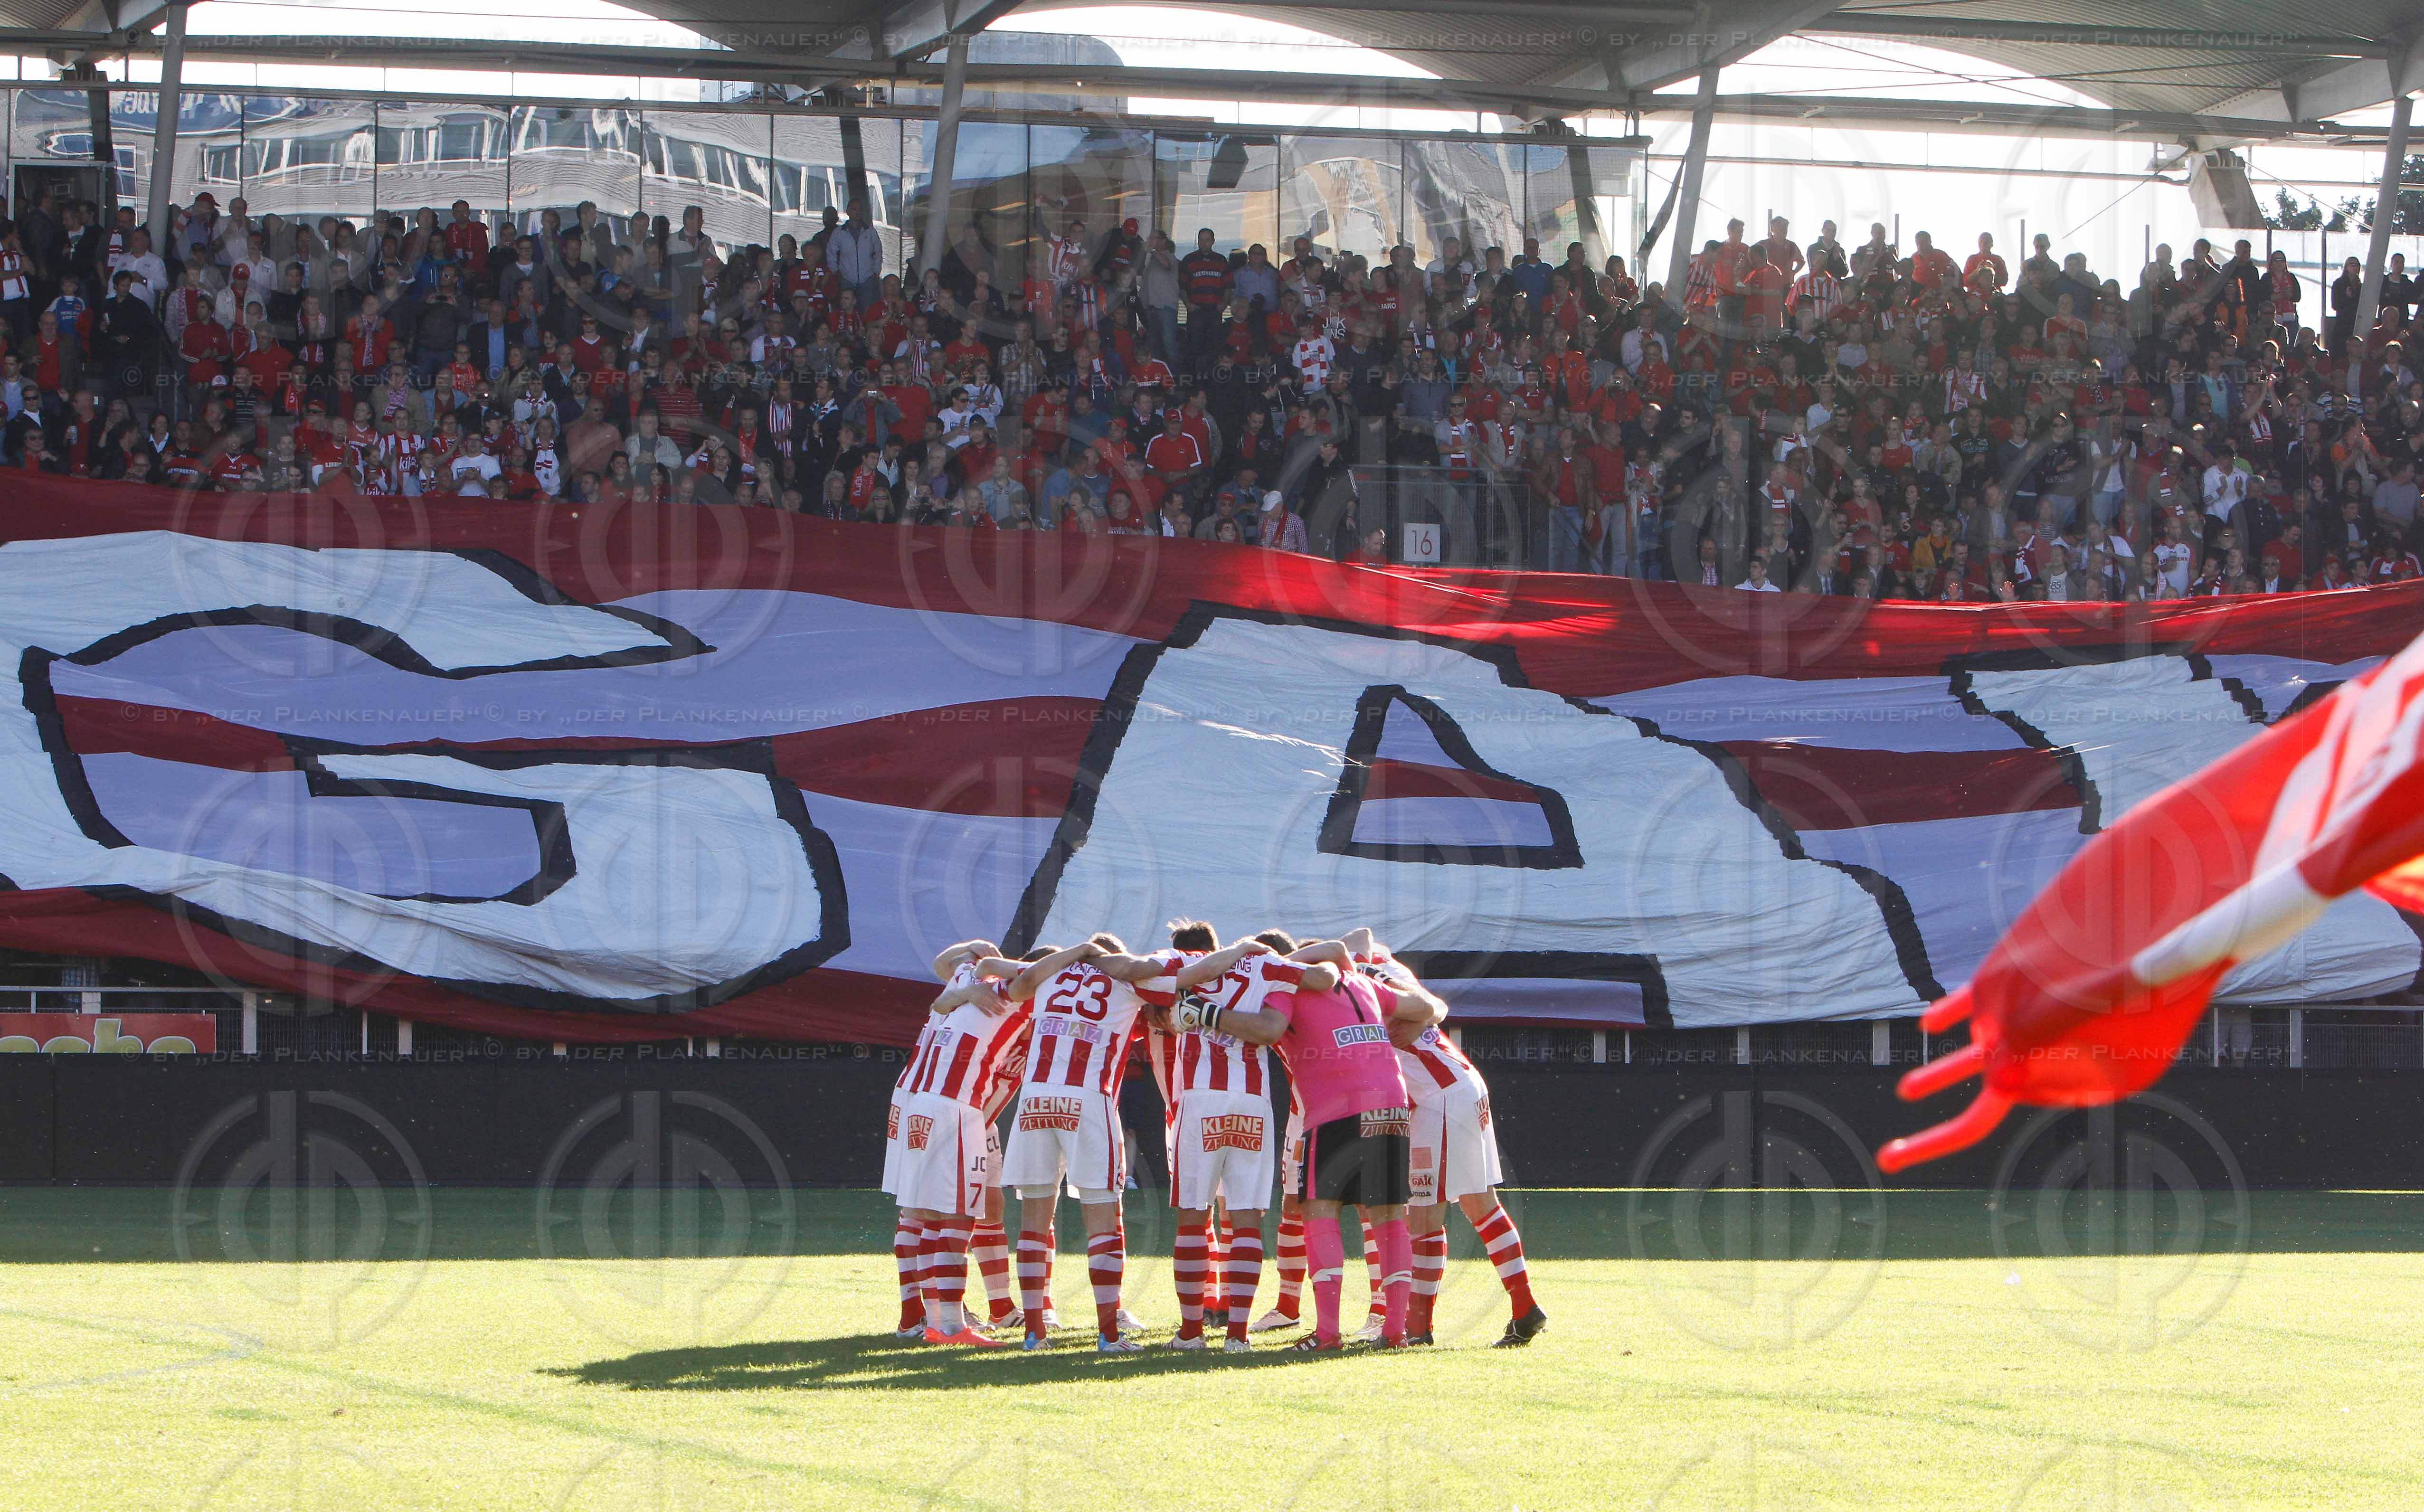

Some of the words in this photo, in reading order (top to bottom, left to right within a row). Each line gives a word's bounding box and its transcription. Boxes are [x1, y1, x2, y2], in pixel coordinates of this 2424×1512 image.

[1411, 529, 1433, 555] 16
[1045, 972, 1112, 1021] 23
[1040, 1020, 1101, 1042] GRAZ
[1337, 1026, 1390, 1044] GRAZ
[1021, 1097, 1082, 1115] KLEINE
[1020, 1117, 1079, 1132] ZEITUNG
[1203, 1114, 1263, 1134] KLEINE
[1204, 1135, 1262, 1152] ZEITUNG
[969, 1182, 982, 1208] 7
